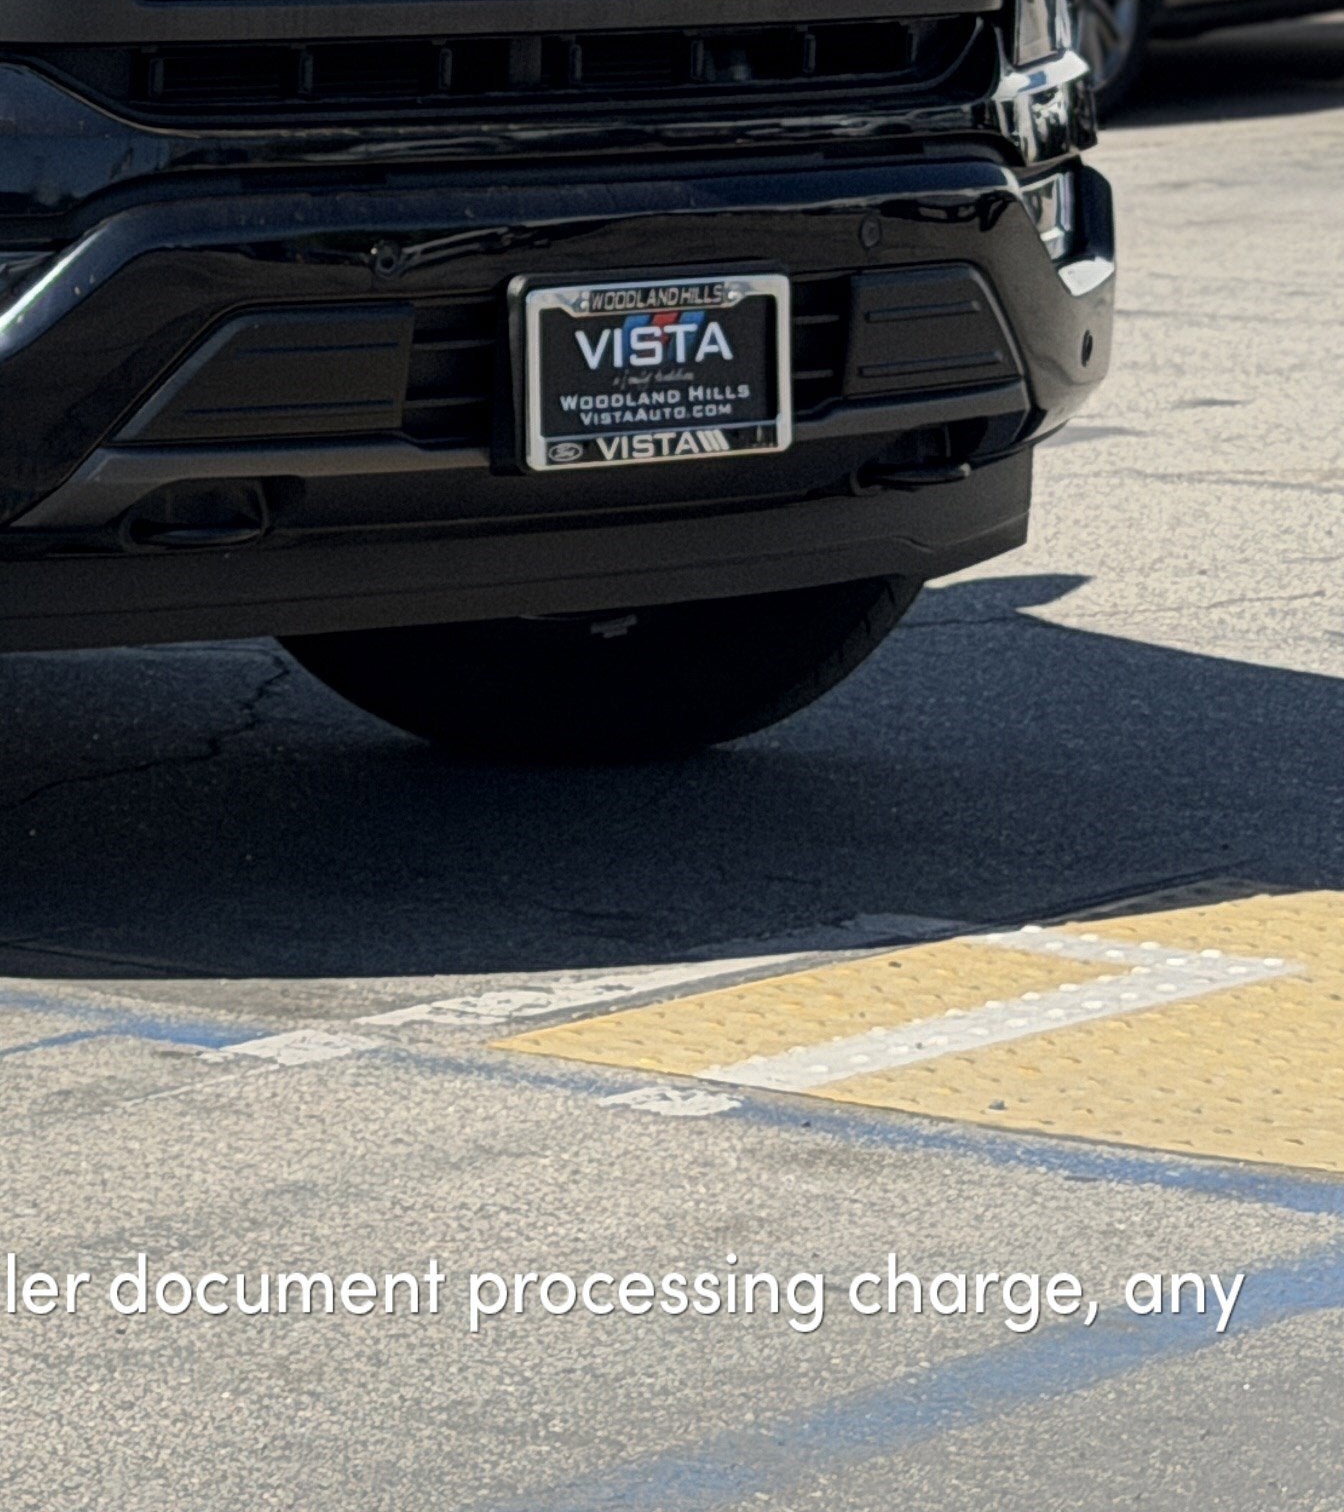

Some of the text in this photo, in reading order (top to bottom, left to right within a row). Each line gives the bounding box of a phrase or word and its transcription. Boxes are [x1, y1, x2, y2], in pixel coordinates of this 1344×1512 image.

[590, 284, 724, 311] WOODLAND HILLS
[574, 320, 734, 370] VISTA
[595, 429, 701, 461] VISTA
